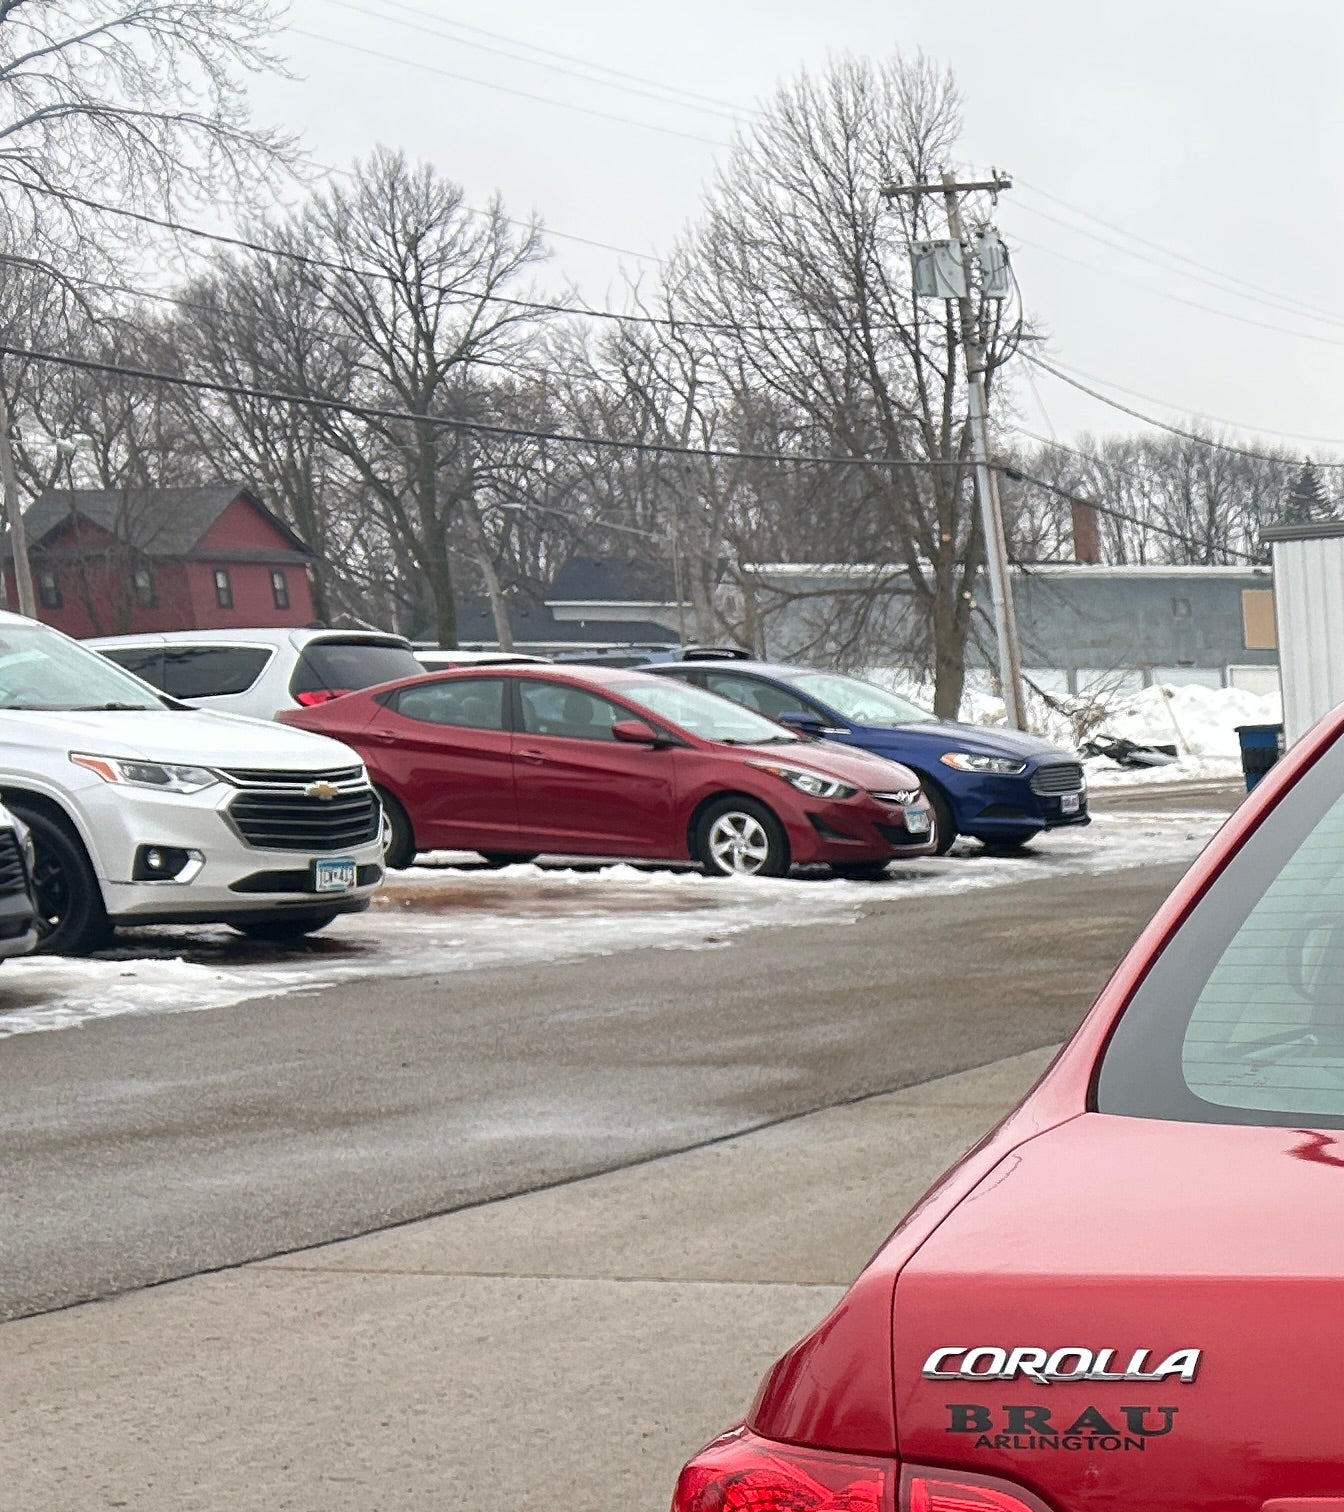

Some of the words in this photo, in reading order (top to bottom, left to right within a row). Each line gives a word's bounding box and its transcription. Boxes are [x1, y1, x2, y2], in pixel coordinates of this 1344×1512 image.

[922, 1347, 1200, 1384] COROLLA
[945, 1404, 1178, 1436] BRAU
[974, 1435, 1145, 1450] ARLINGTON
